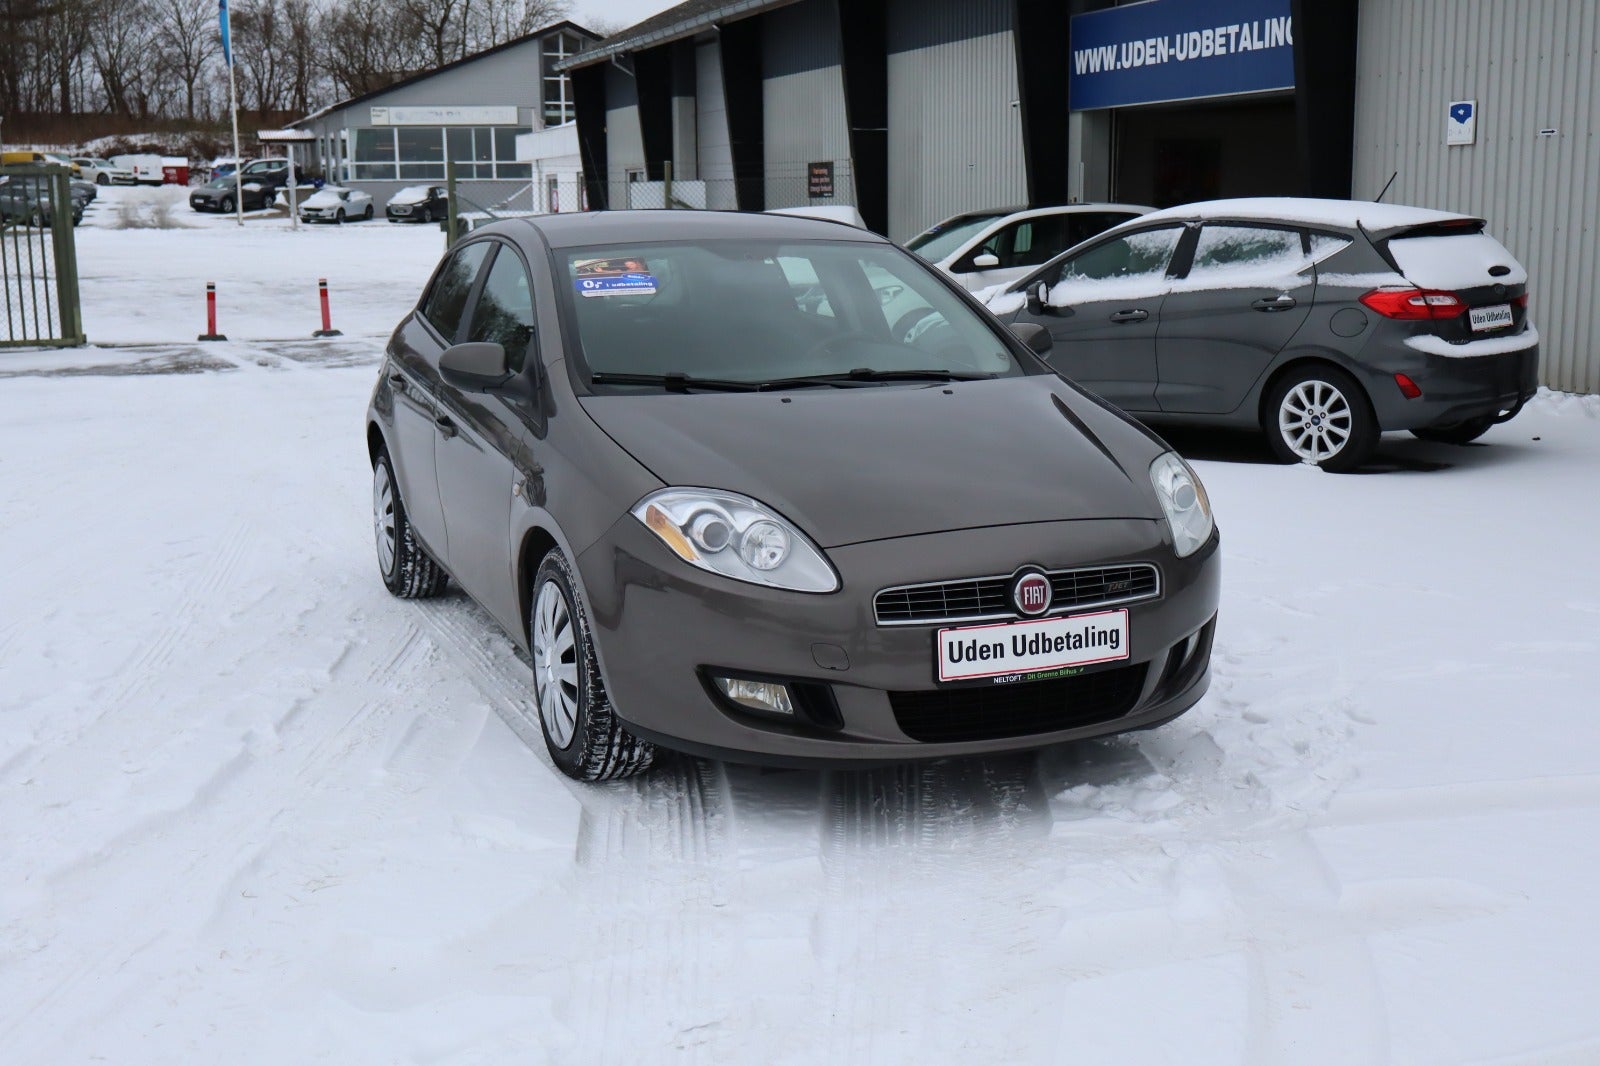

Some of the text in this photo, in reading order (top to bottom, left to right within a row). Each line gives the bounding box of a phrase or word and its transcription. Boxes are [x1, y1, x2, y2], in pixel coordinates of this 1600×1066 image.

[1471, 314, 1486, 324] Uden
[1023, 585, 1045, 606] FIAT
[948, 626, 1120, 664] Uden Udbetaling
[993, 674, 1022, 684] NELTOFT
[1059, 668, 1077, 676] Bilhus
